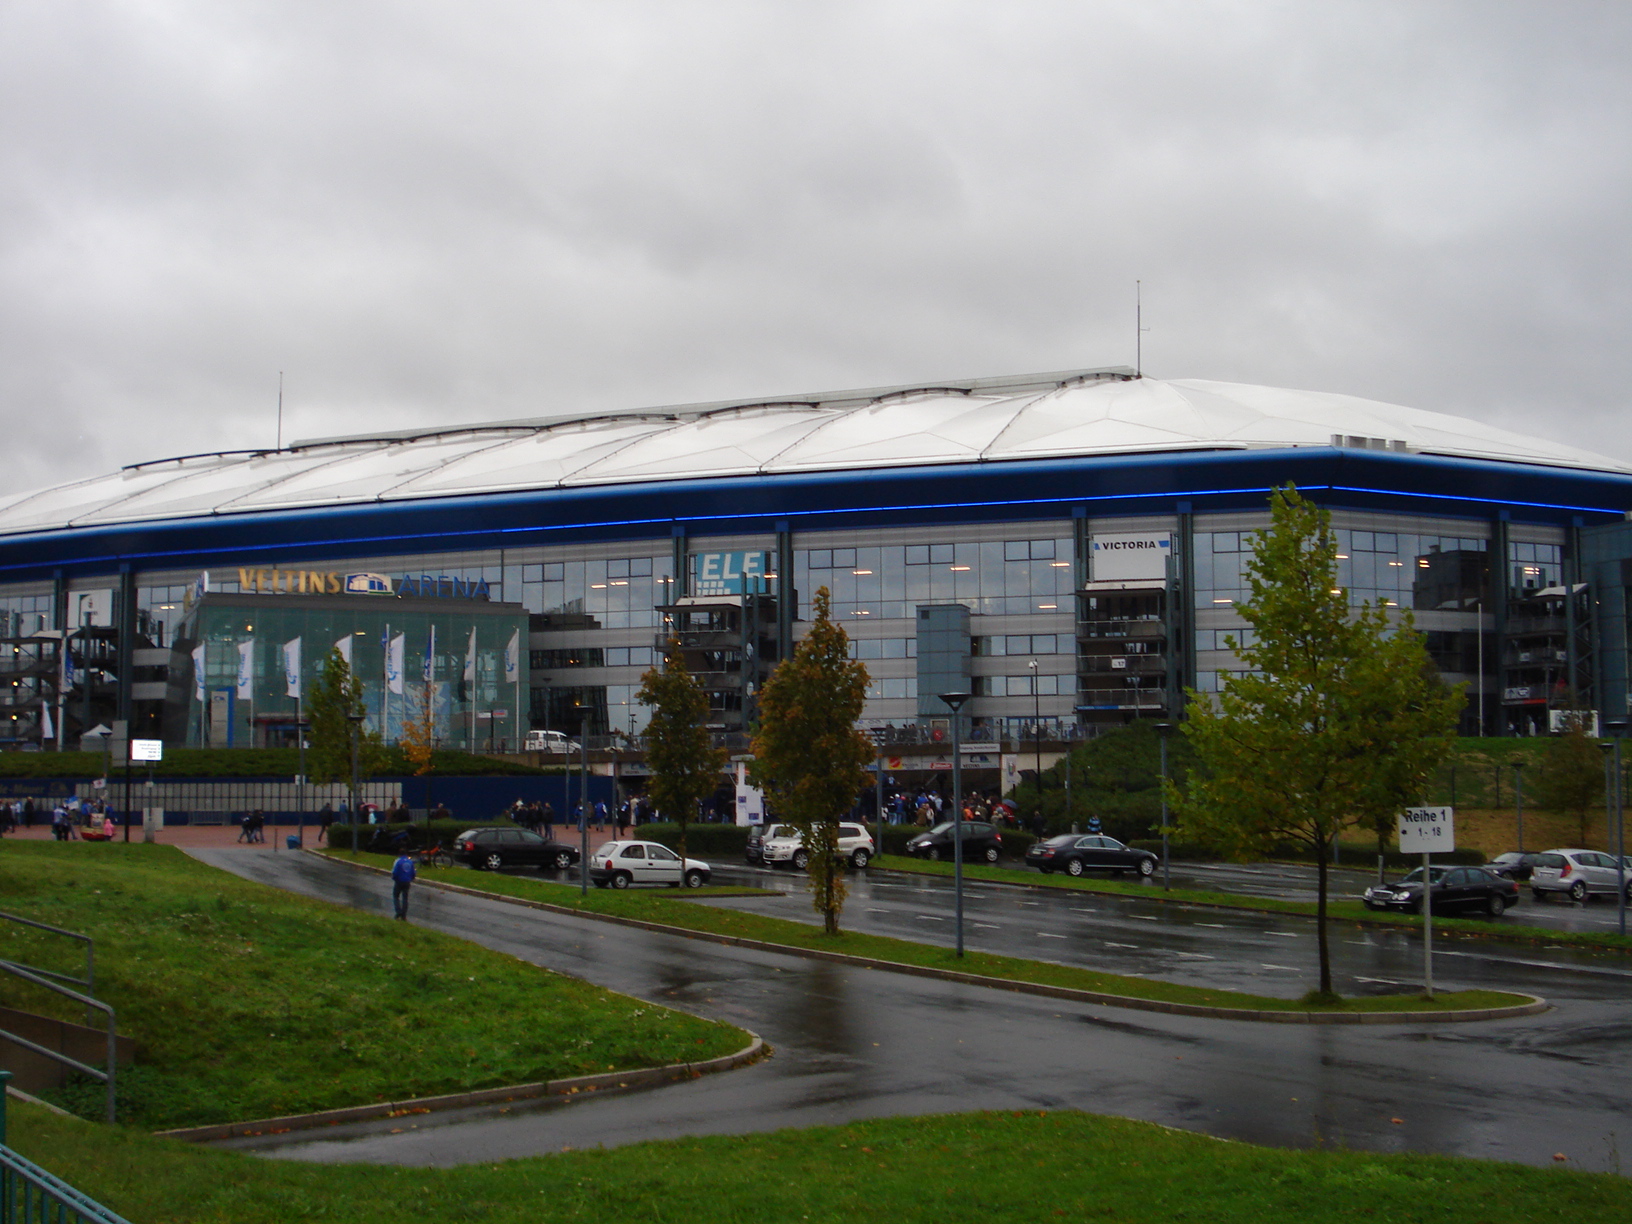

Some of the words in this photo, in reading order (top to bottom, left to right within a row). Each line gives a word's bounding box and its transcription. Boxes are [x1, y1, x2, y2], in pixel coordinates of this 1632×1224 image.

[1102, 541, 1156, 550] VICTORIA
[702, 552, 761, 580] ELE
[238, 568, 341, 594] VELTINS
[397, 574, 491, 598] ARENA
[1405, 809, 1437, 822] Reihe
[1440, 809, 1446, 821] 1
